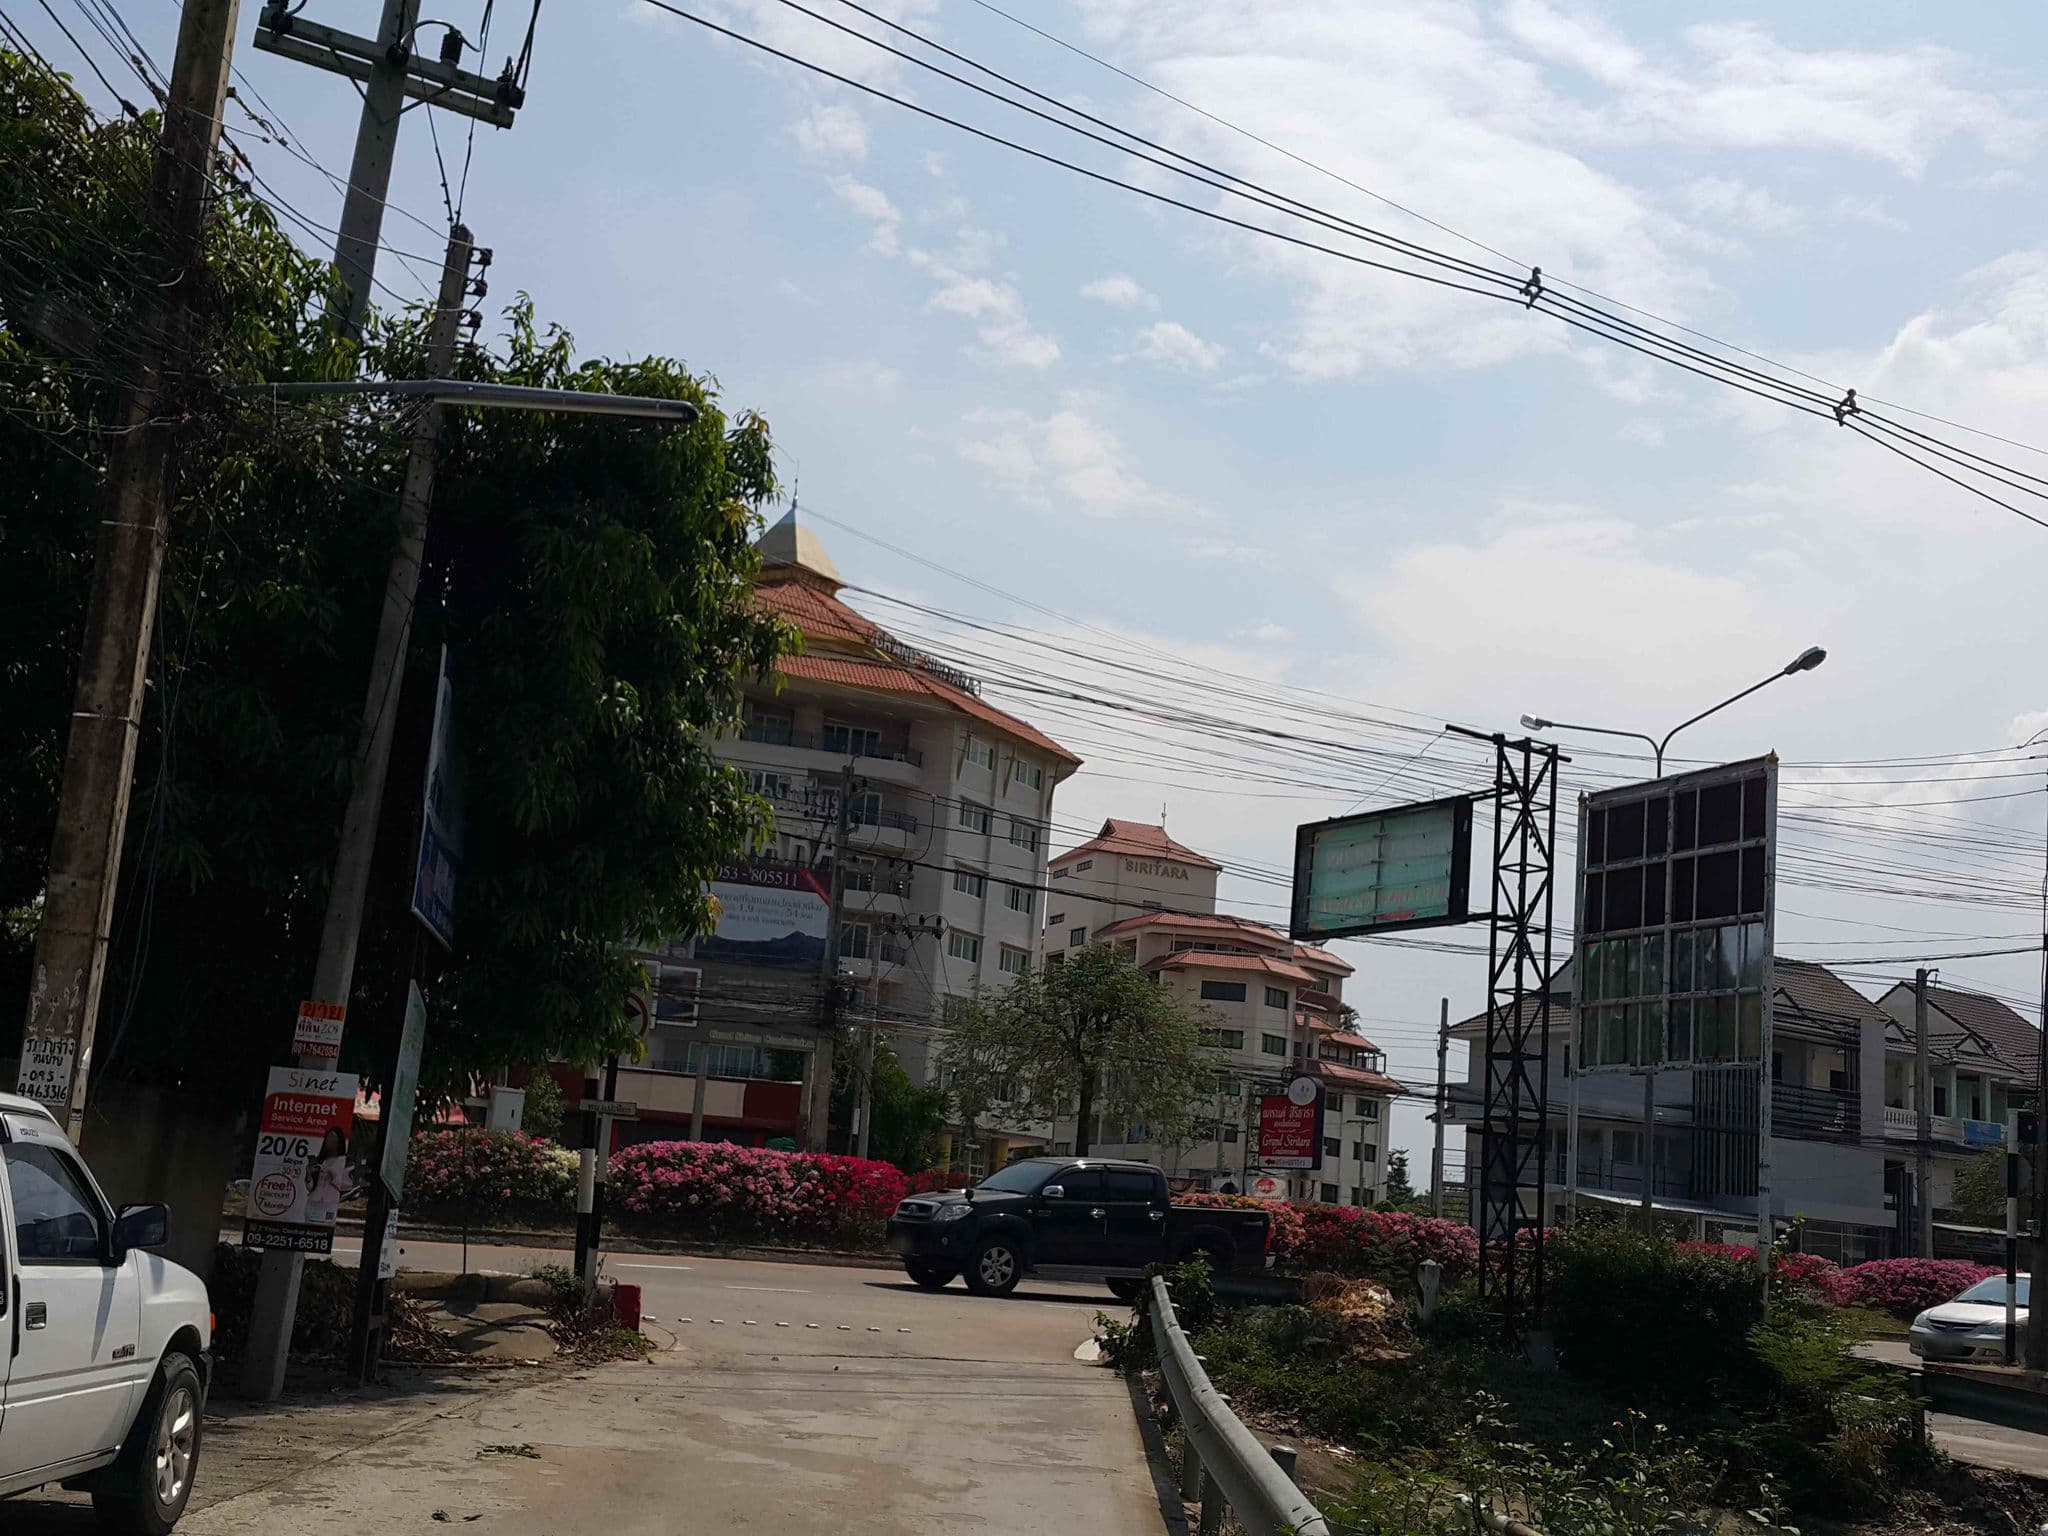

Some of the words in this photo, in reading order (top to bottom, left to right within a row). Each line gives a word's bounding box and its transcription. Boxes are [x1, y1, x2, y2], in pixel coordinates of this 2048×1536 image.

[751, 868, 797, 887] 805511
[1125, 860, 1189, 881] SIRITARA
[18, 1083, 67, 1101] 4463316
[273, 1097, 339, 1116] Internet
[272, 1113, 304, 1124] Service
[306, 1116, 327, 1126] Area
[259, 1136, 308, 1158] 20/6
[247, 1232, 329, 1250] 09-2251-6518
